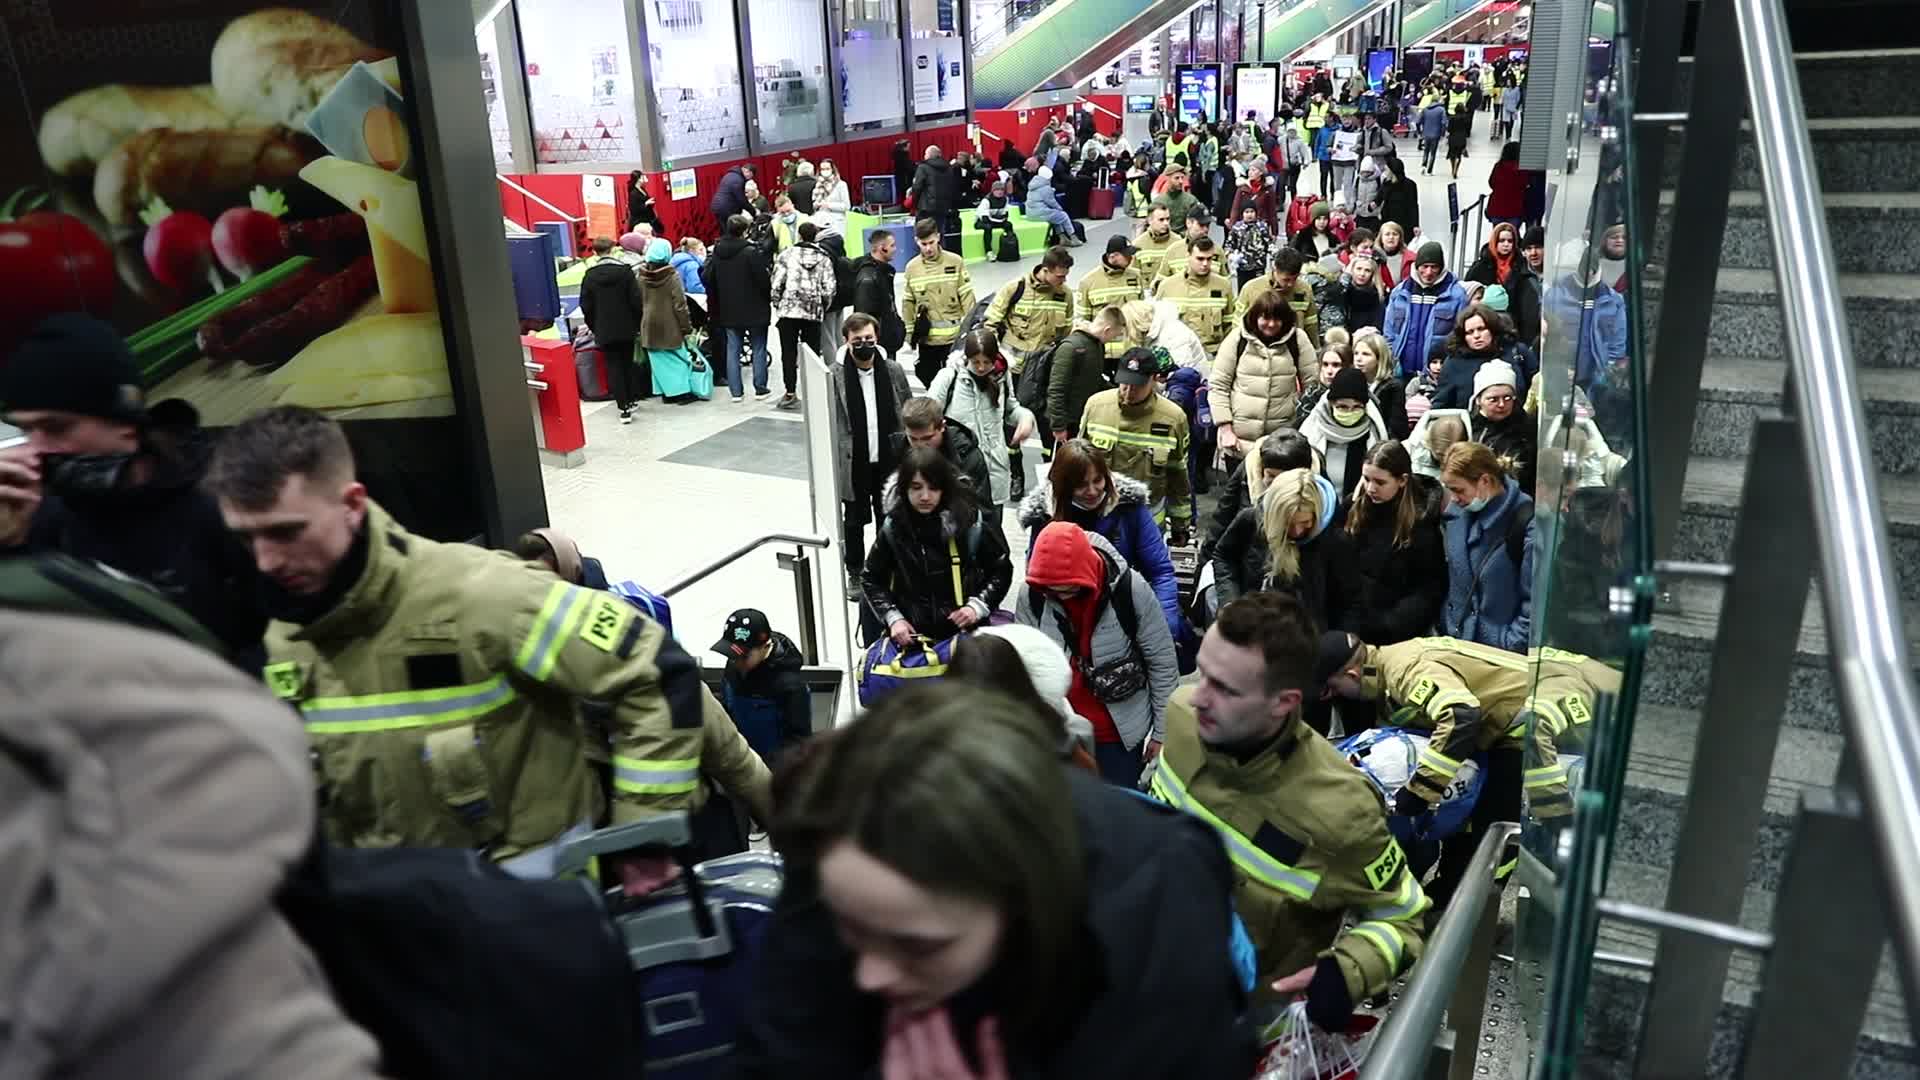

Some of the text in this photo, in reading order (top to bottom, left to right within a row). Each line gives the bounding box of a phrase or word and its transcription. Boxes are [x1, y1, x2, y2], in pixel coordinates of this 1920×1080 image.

[591, 602, 619, 640] PSP
[1414, 679, 1429, 700] PSP
[1374, 846, 1397, 882] PSP
